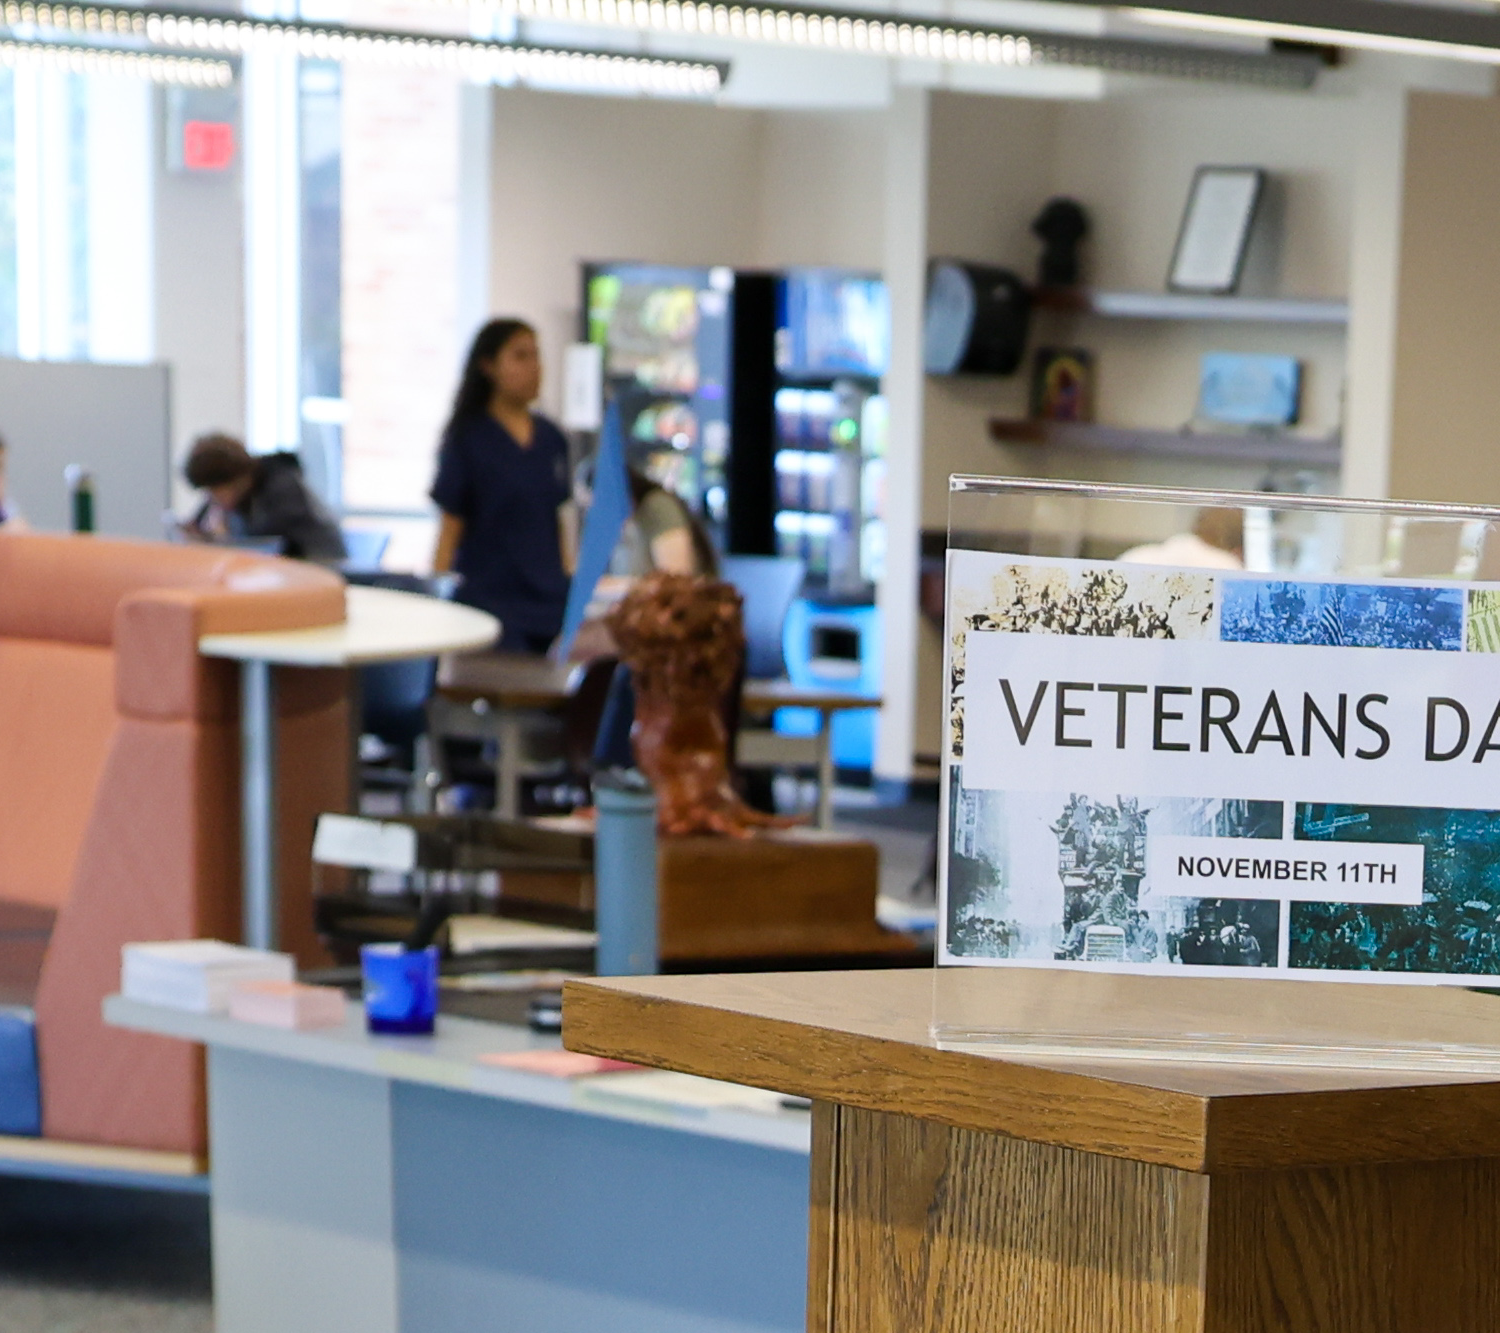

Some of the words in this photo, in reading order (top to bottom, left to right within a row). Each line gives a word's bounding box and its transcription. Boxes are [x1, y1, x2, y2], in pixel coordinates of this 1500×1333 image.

[999, 678, 1390, 761] VETERANS
[1177, 856, 1328, 882] NOVEMBER
[1338, 859, 1397, 884] 11TH
